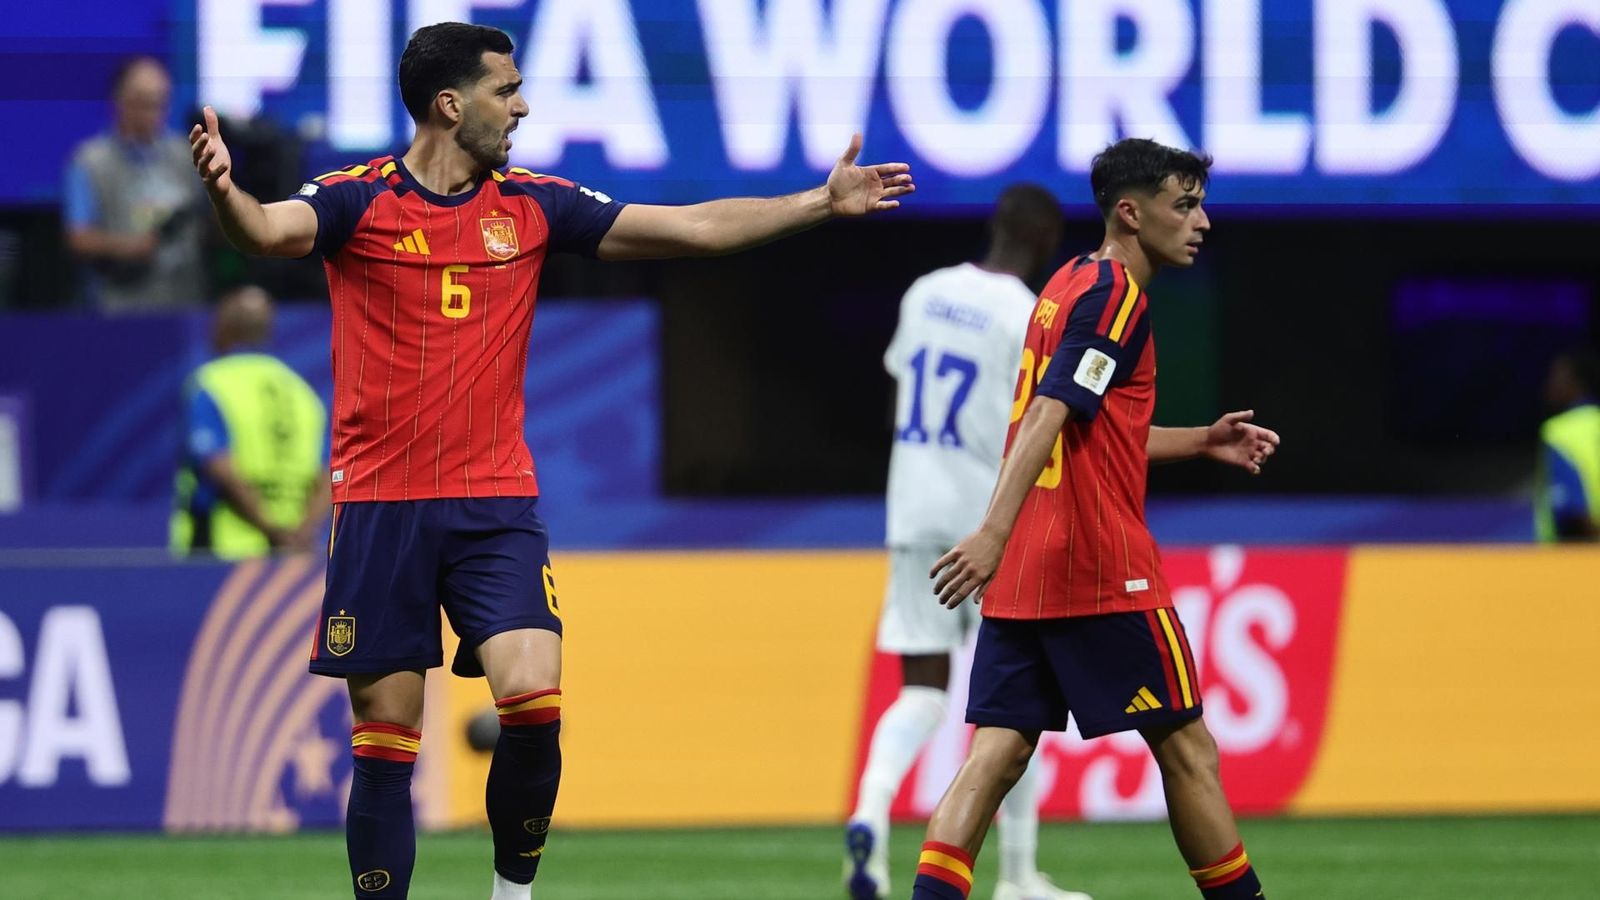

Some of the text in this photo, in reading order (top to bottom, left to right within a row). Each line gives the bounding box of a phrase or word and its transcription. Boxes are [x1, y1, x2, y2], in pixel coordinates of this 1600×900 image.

[196, 0, 671, 168] FIA
[694, 0, 1460, 178] WORLD
[441, 265, 471, 318] 6
[897, 345, 978, 447] 17
